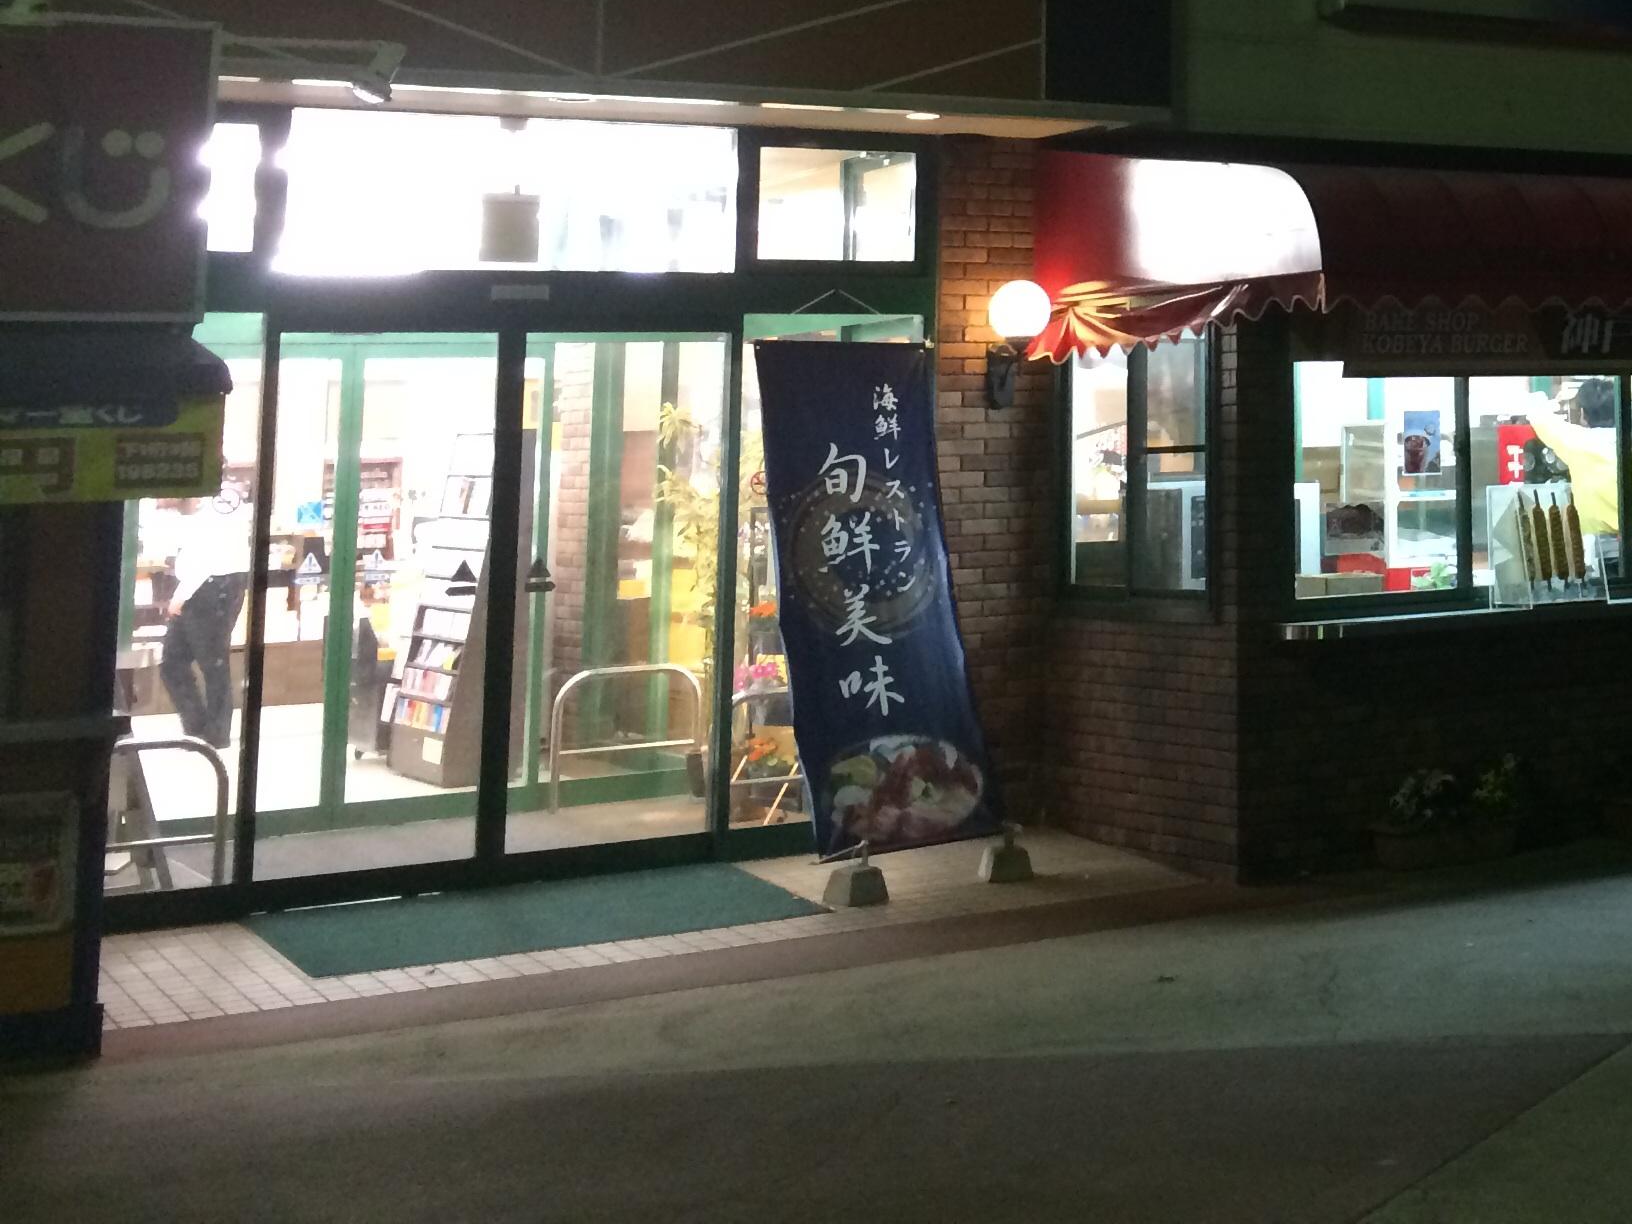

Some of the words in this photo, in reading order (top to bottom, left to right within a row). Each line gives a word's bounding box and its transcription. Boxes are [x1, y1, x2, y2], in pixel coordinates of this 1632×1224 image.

[1360, 332, 1444, 354] KOBEYA
[1450, 332, 1530, 354] BURGER
[1425, 312, 1480, 332] SHOP
[872, 383, 918, 593] 海鮮レストラン
[816, 441, 905, 717] 旬鮮美味
